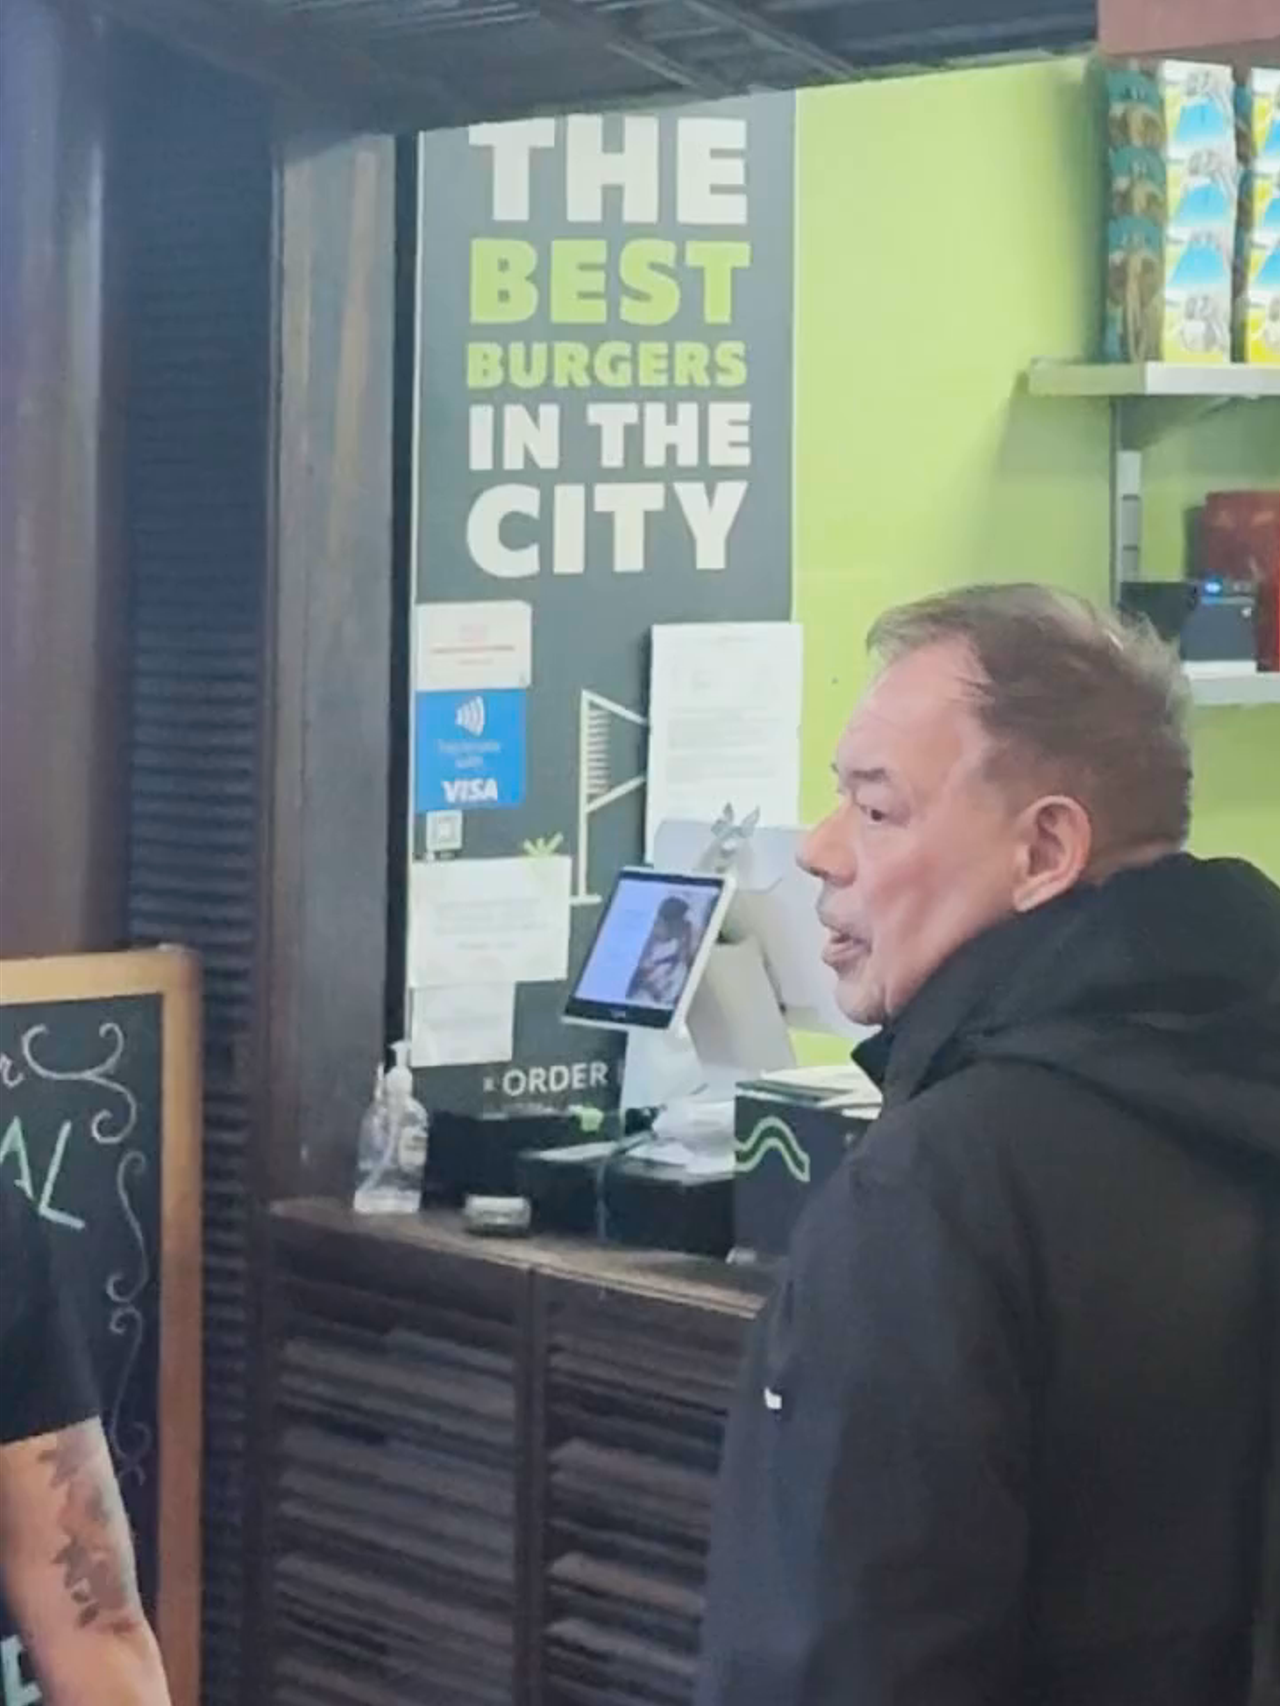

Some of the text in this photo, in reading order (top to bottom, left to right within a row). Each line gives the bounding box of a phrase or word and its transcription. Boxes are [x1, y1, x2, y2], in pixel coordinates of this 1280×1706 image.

[468, 114, 748, 225] THE
[468, 239, 751, 325] BEST
[466, 341, 748, 388] BURGERS
[468, 402, 751, 470] IN THE
[466, 480, 748, 578] CITY
[441, 778, 498, 804] VISA
[502, 1061, 609, 1097] ORDER
